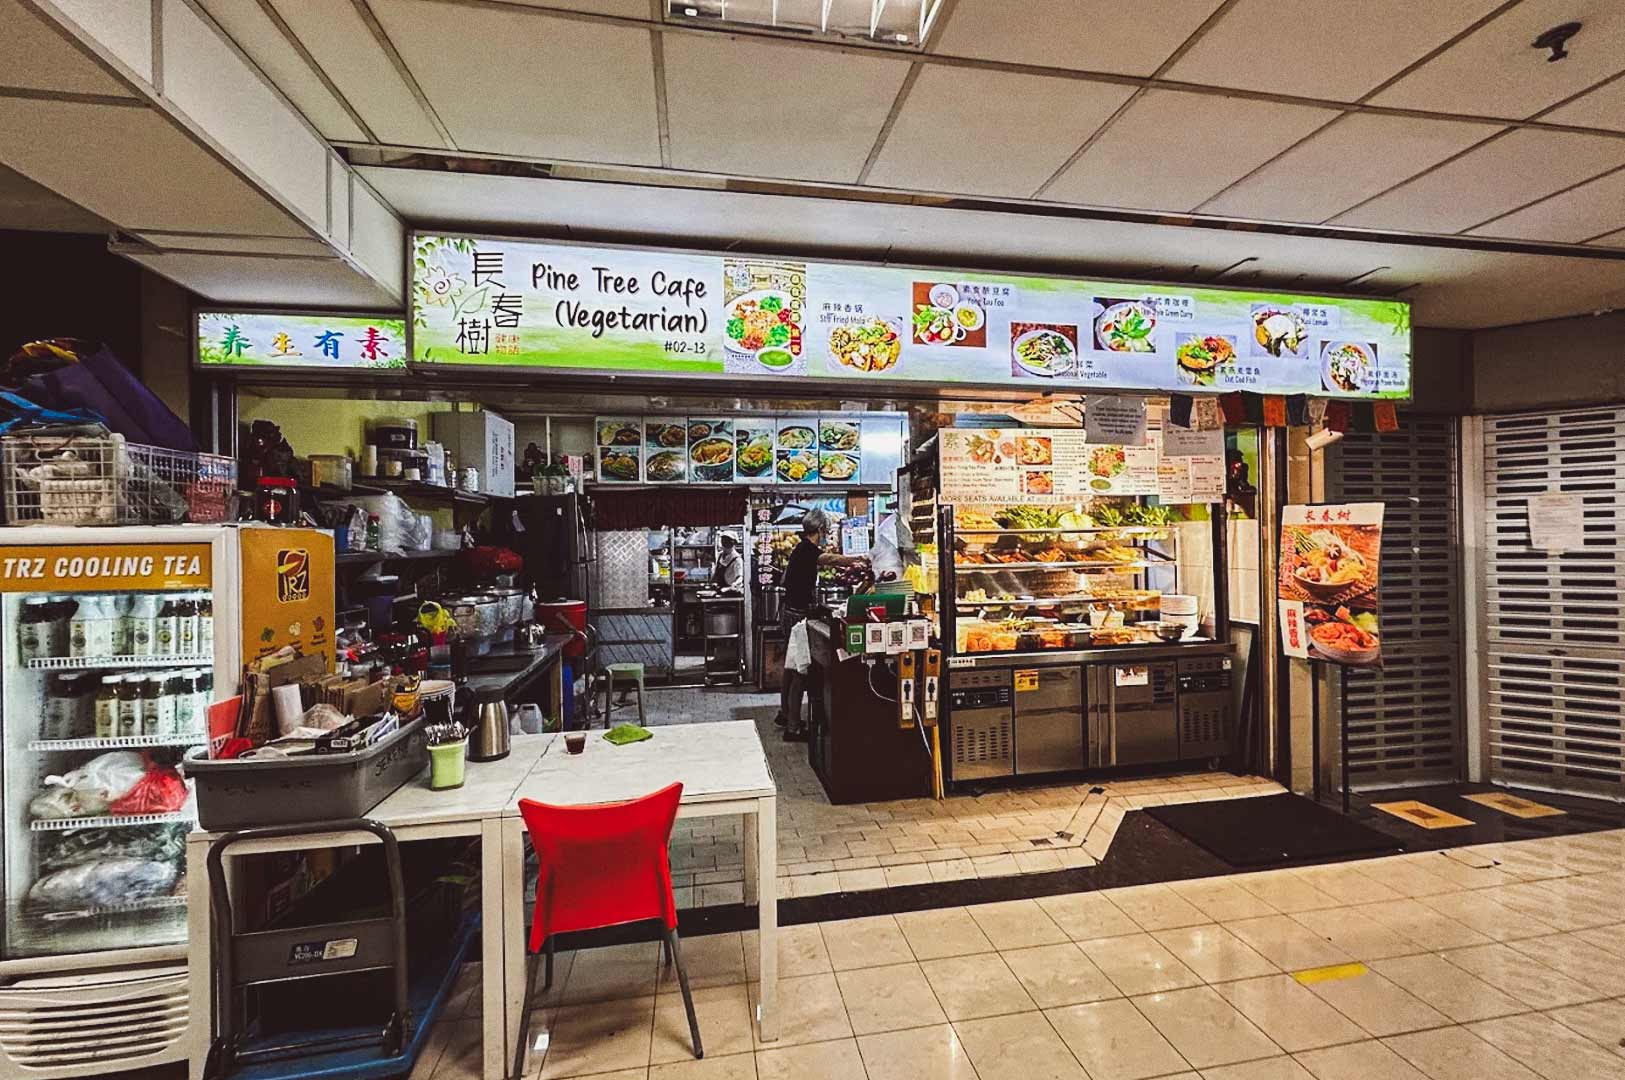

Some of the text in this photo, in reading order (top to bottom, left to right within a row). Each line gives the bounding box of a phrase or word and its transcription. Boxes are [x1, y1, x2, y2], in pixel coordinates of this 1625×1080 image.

[532, 263, 579, 290] Pine
[592, 267, 639, 294] Tree
[651, 271, 707, 306] Cafe
[555, 300, 707, 338] (Vegetarian)
[219, 324, 389, 361] 养生有素
[664, 340, 706, 354] #02-13
[1080, 370, 1107, 379] Vegetable
[964, 495, 988, 503] SEATS
[4, 555, 201, 578] TRZ COOLING TEA
